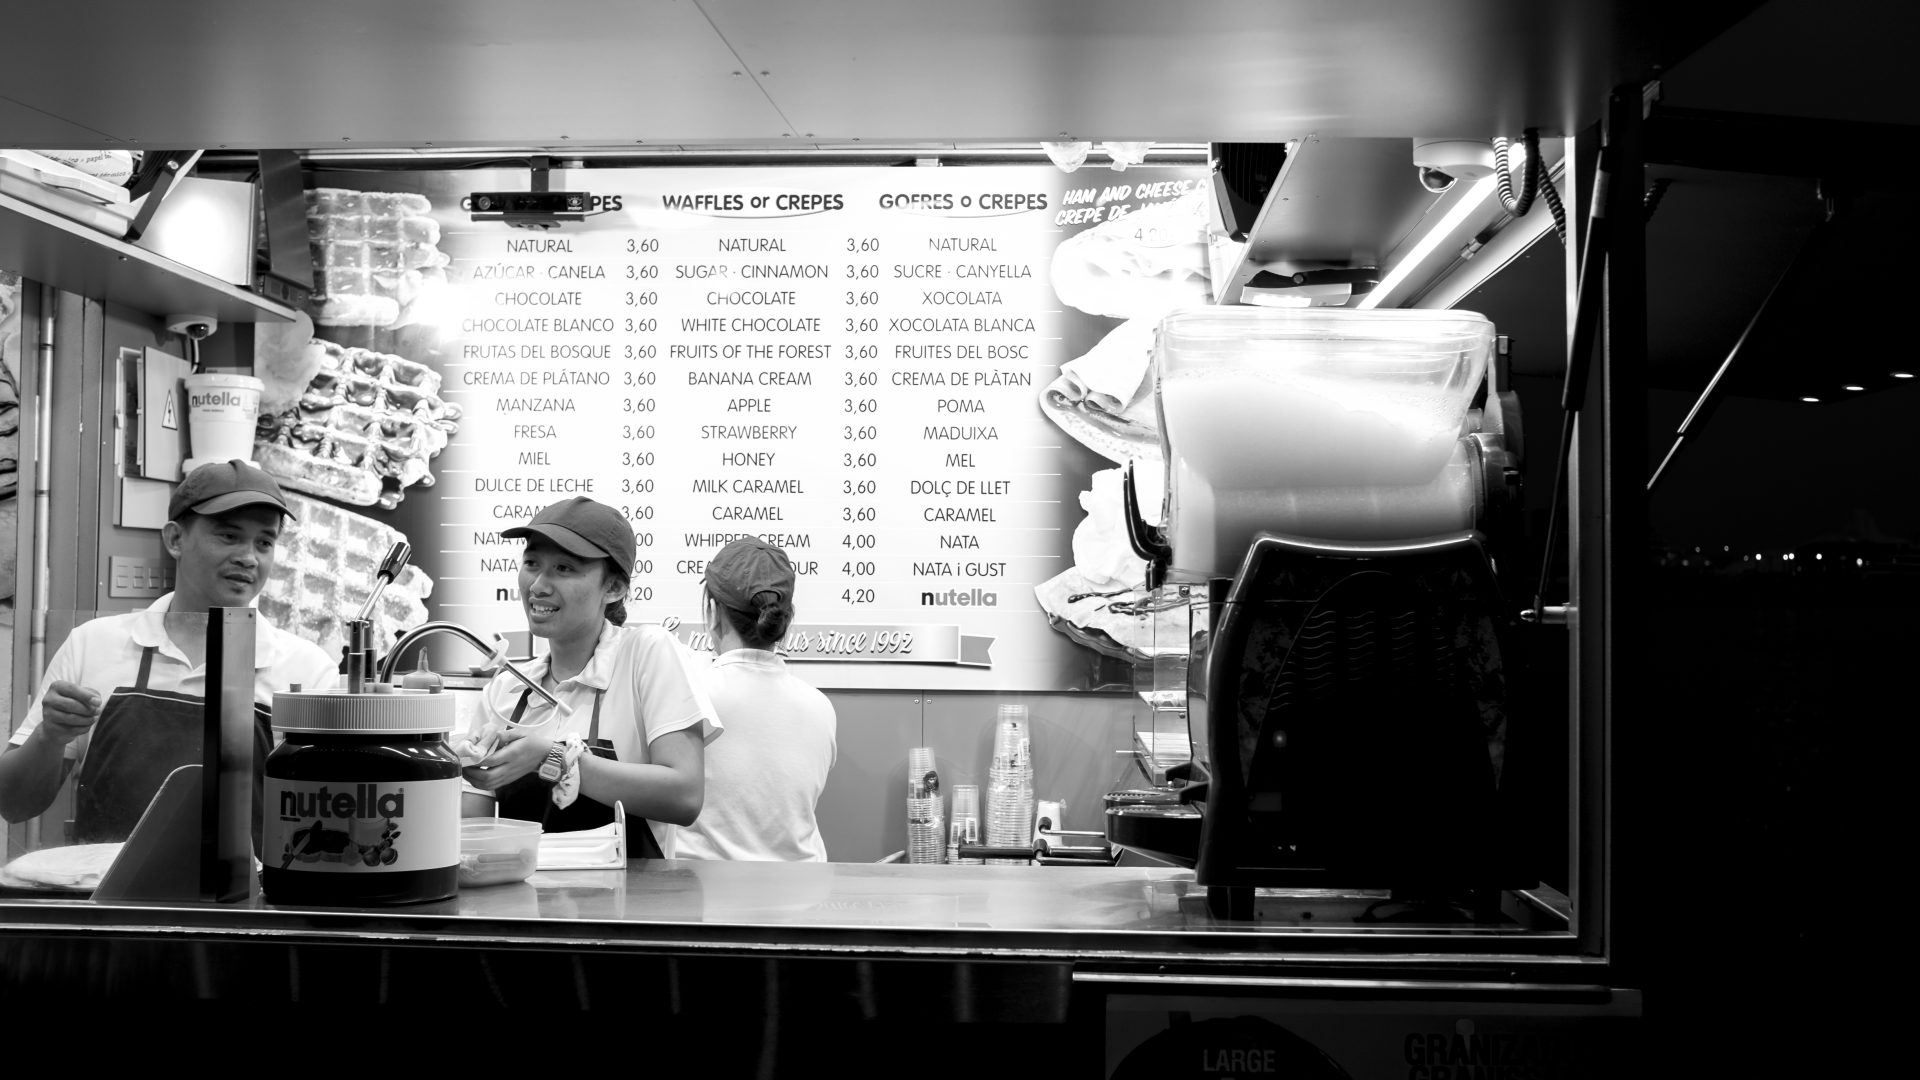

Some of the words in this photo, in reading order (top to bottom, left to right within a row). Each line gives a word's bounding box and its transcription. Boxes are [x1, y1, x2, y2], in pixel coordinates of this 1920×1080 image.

[1062, 188, 1097, 206] HAM
[1099, 185, 1132, 202] AND
[1135, 180, 1193, 199] CHEESE
[590, 195, 622, 211] PES
[662, 195, 743, 210] WAFFLES
[750, 196, 770, 208] or
[775, 194, 844, 210] CREPES
[879, 194, 953, 210] GOFRES
[979, 194, 1048, 209] CREPES
[1055, 207, 1105, 226] CREPE
[507, 239, 573, 253] NATURAL
[627, 239, 659, 254] 3,60
[719, 238, 786, 252] NATURAL
[847, 238, 879, 253] 3,60
[929, 238, 997, 251] NATURAL
[548, 265, 605, 279] CANELA
[626, 265, 658, 280] 3,60
[676, 265, 727, 278] SUGAR
[741, 265, 828, 278] CINNAMON
[847, 265, 879, 280] 3,60
[894, 265, 942, 278] SUCRE
[956, 265, 1031, 278] CANYELLA
[495, 292, 582, 305] CHOCOLATE
[626, 292, 657, 307] 3,60
[707, 291, 796, 305] CHOCOLATE
[846, 291, 878, 307] 3,60
[922, 291, 1002, 305] XOCOLATA
[463, 318, 549, 332] CHOCOLATE
[554, 318, 614, 332] BLANCO
[625, 318, 657, 333] 3,60
[682, 318, 726, 332] WHITE
[732, 318, 820, 332] CHOCOLATE
[846, 318, 878, 334] 3,60
[889, 318, 969, 332] XOCOLATA
[975, 318, 1035, 332] BLANCA
[463, 345, 516, 359] FRUTAS
[521, 345, 545, 358] DEL
[551, 345, 611, 358] BOSQUE
[625, 345, 656, 360] 3,60
[670, 345, 718, 358] FRUITS
[723, 345, 742, 358] OF
[746, 345, 773, 358] THE
[779, 345, 831, 358] FOREST
[845, 345, 878, 360] 3,60
[896, 345, 952, 358] FRUITES
[957, 345, 982, 359] DEL
[988, 345, 1028, 359] BOSC
[464, 372, 514, 385] CREMA
[520, 372, 538, 385] DE
[543, 369, 609, 385] PLÁTANO
[624, 372, 656, 387] 3,60
[689, 372, 754, 385] BANANA
[759, 372, 811, 385] CREAM
[845, 372, 877, 387] 3,60
[892, 372, 945, 386] CREMA
[951, 372, 969, 386] DE
[192, 392, 240, 408] nutella
[496, 399, 575, 412] MANZANA
[624, 398, 655, 414] 3,60
[727, 399, 771, 412] APPLE
[845, 399, 877, 414] 3,60
[938, 399, 985, 413] POMA
[514, 425, 557, 438] FRESA
[623, 425, 655, 440] 3,60
[701, 425, 797, 439] STRAWBERRY
[844, 426, 876, 442] 3,60
[924, 426, 998, 440] MADUIXA
[519, 452, 551, 465] MIEL
[622, 452, 654, 467] 3,60
[723, 453, 775, 466] HONEY
[844, 453, 876, 468] 3,60
[946, 454, 975, 467] MEL
[475, 478, 522, 492] DULCE
[527, 479, 544, 492] DE
[550, 479, 593, 492] LECHE
[622, 479, 654, 494] 3,60
[693, 480, 728, 493] MILK
[733, 480, 804, 493] CARAMEL
[843, 480, 876, 496] 3,60
[911, 480, 951, 497] DOLÇ
[957, 481, 975, 494] DE
[981, 481, 1010, 495] LLET
[622, 506, 653, 521] 3,60
[712, 507, 783, 520] CARAMEL
[843, 507, 876, 523] 3,60
[924, 508, 996, 522] CARAMEL
[474, 532, 512, 545] NATA
[685, 534, 750, 547] WHIPP
[842, 535, 875, 550] 4,00
[941, 535, 979, 549] NATA
[481, 558, 518, 572] NATA
[676, 560, 712, 574] CRE
[842, 562, 875, 577] 4,00
[913, 562, 952, 576] NATA
[965, 563, 1006, 576] GUST
[842, 589, 875, 605] 4,20
[922, 589, 997, 606] nutella
[816, 630, 866, 654] since
[870, 630, 912, 654] 1992
[280, 784, 404, 819] nutella
[1203, 1048, 1276, 1072] LARGE
